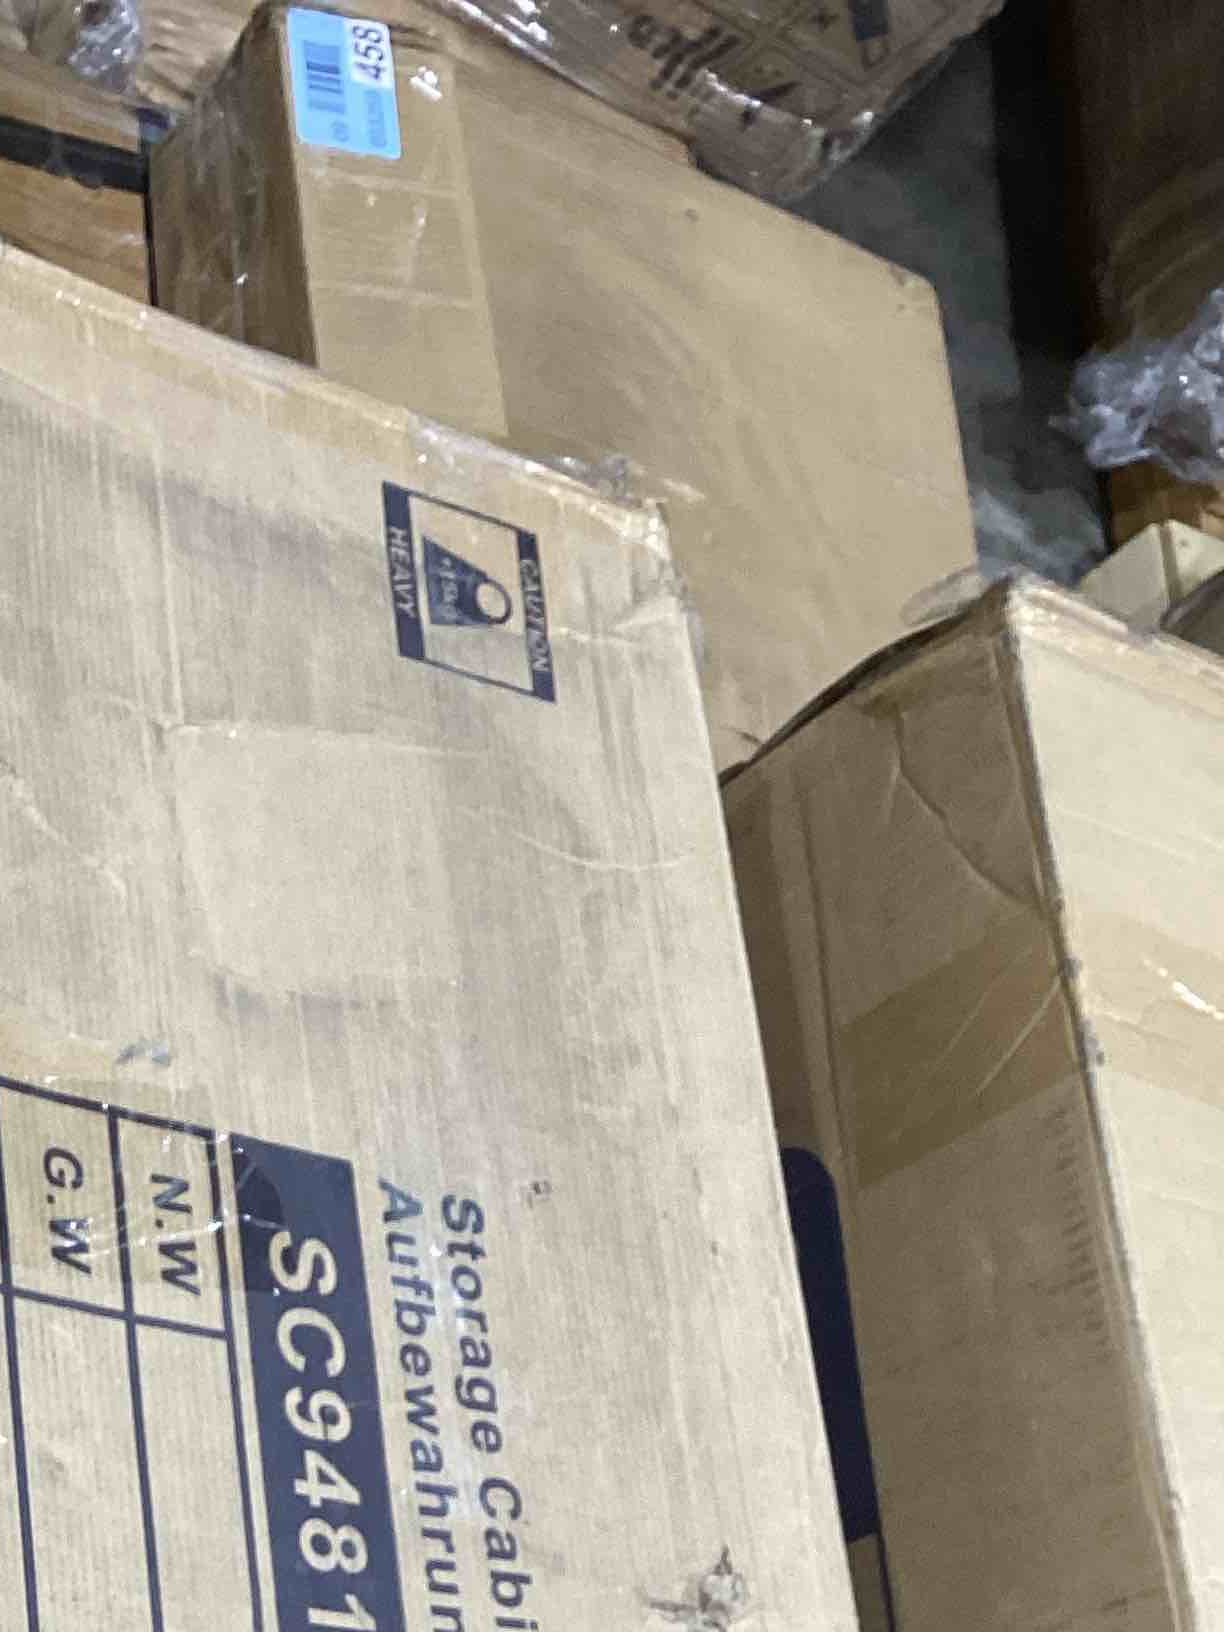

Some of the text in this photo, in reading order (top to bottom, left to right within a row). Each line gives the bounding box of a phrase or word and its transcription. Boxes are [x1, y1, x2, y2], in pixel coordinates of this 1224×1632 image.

[352, 26, 386, 80] 458
[389, 526, 418, 619] HEAVY
[520, 559, 552, 672] CAUTION
[43, 1146, 92, 1275] G.W
[150, 1172, 200, 1296] N.W
[441, 1195, 503, 1453] Storage
